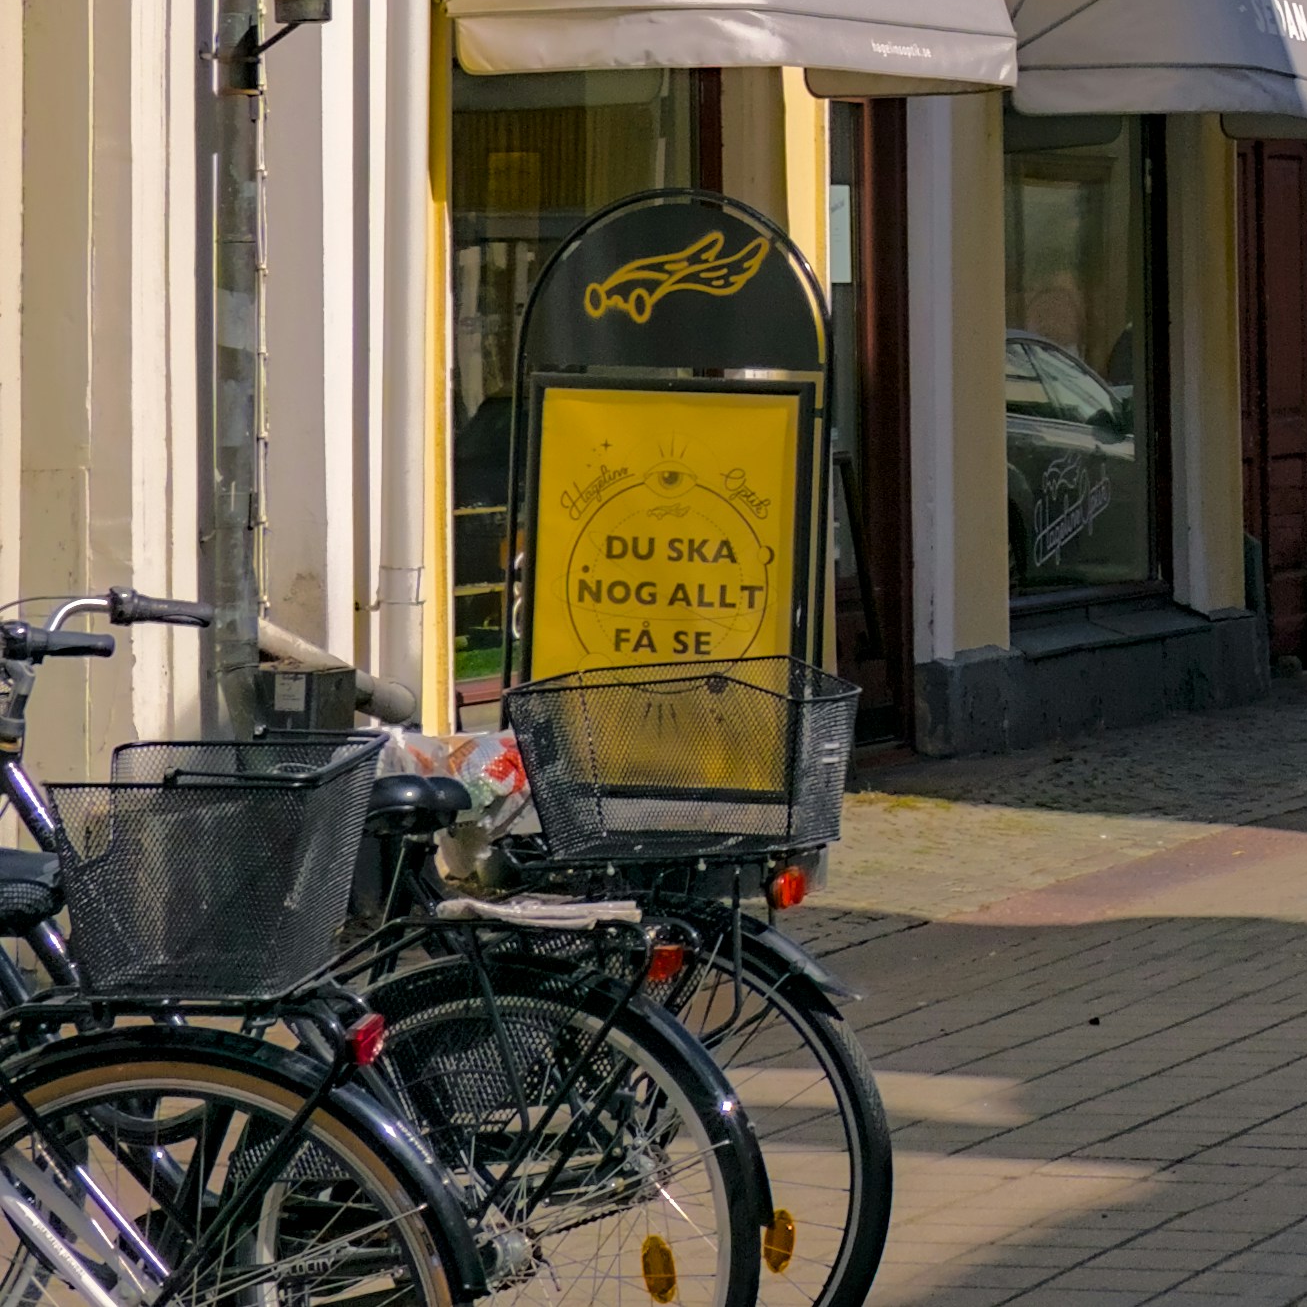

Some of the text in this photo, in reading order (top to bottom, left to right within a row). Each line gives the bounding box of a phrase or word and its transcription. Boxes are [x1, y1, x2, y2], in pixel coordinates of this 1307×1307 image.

[605, 535, 738, 564] DU SKA
[577, 579, 764, 609] NOG ALLT
[614, 620, 712, 656] FÅ SE
